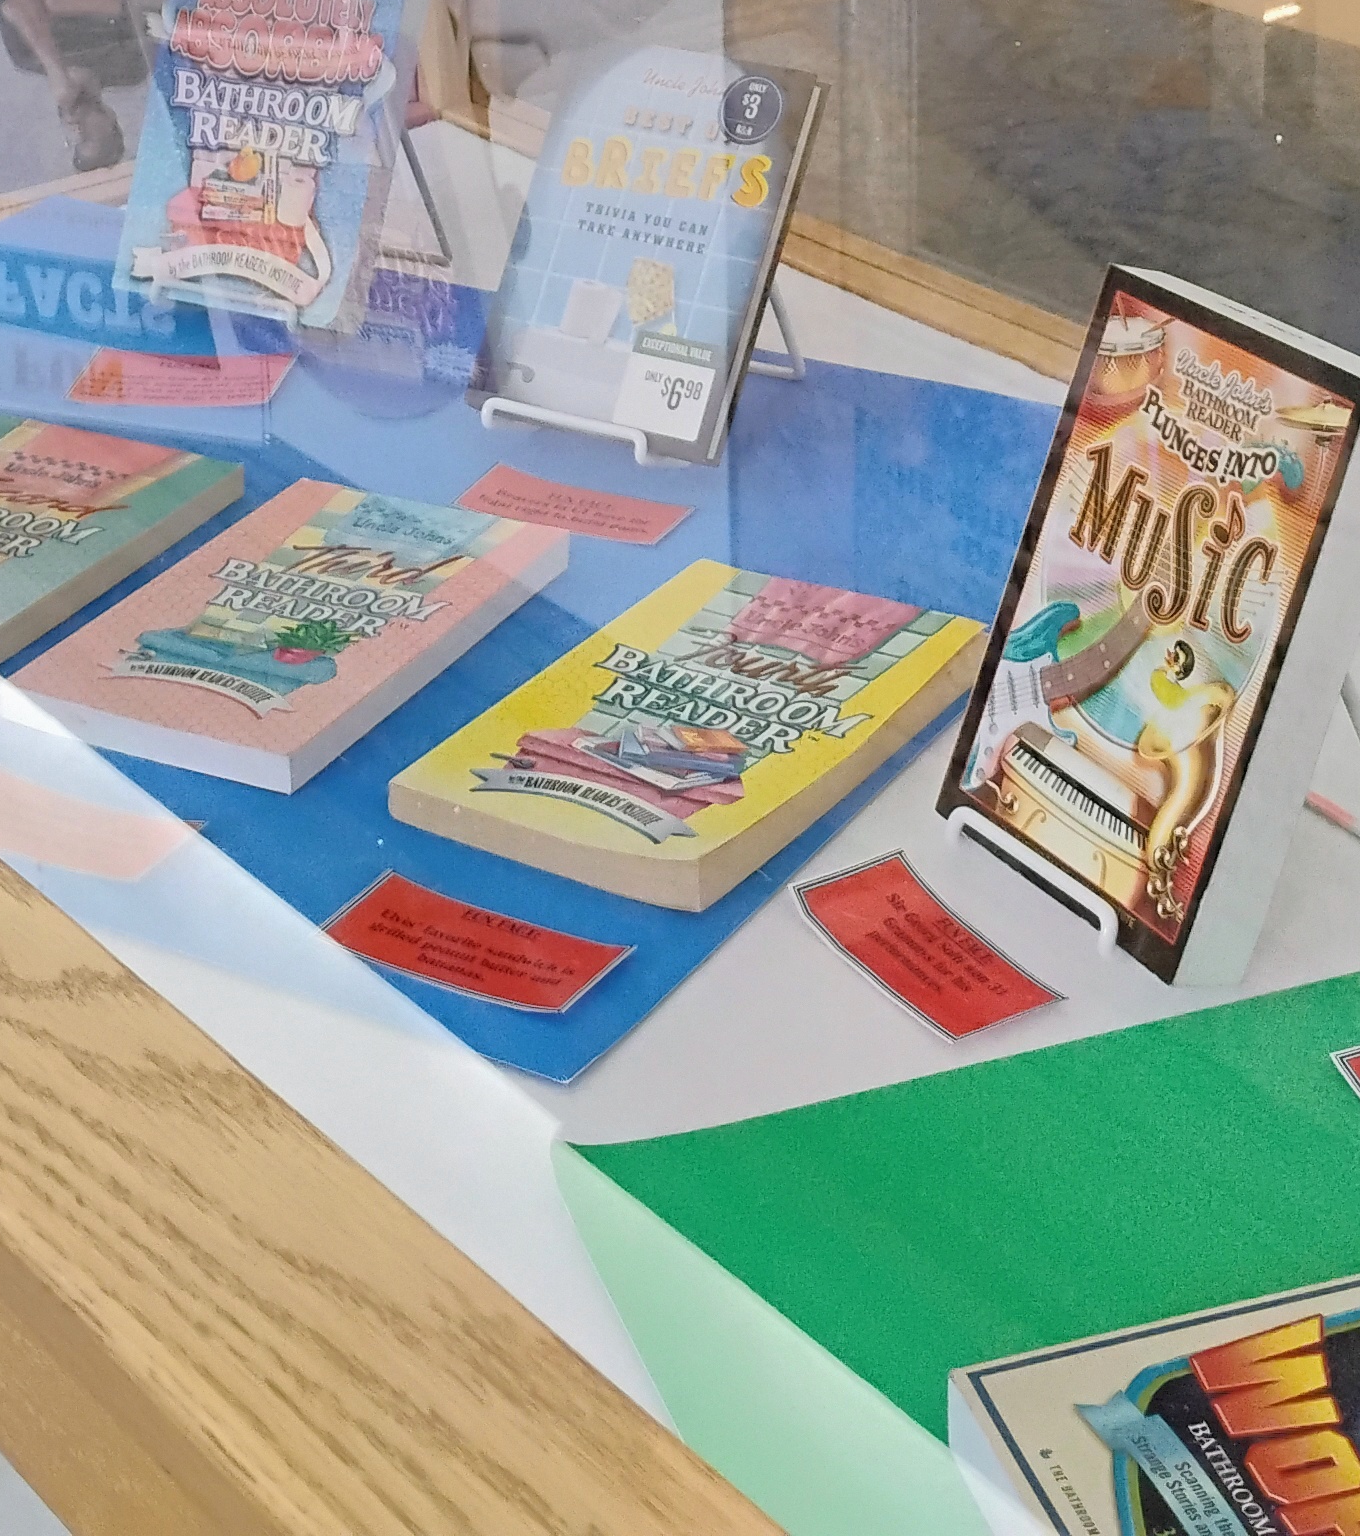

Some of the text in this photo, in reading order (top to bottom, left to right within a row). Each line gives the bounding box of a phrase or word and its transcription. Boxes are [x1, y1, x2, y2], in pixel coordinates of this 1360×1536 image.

[170, 6, 386, 85] ABSORBING
[172, 68, 366, 135] BATHROOM
[642, 68, 687, 91] Uncle
[748, 80, 769, 94] ONLY
[623, 104, 693, 136] BEST
[742, 92, 761, 120] $3
[189, 111, 331, 167] READER
[560, 135, 773, 208] BRIEFS
[578, 219, 707, 255] TAKE ANYWHERE
[586, 202, 709, 236] TRIVIA YOU CAN
[192, 251, 234, 269] BATHROOM
[268, 266, 304, 295] INSTITUTE
[641, 336, 714, 362] EXCEPTIONAL VALUE
[644, 369, 663, 383] ONLY
[1174, 348, 1273, 415] Uncle John's
[1182, 379, 1259, 431] BATHROOM
[1186, 402, 1243, 443] READER
[1142, 387, 1223, 474] PLUNGES
[352, 515, 400, 534] Uncle
[286, 543, 466, 585] Third
[205, 583, 389, 637] READER
[207, 556, 453, 622] BATHROOM
[674, 629, 868, 698] Fourth
[592, 643, 875, 738] BATHROOM
[592, 676, 805, 754] READER
[523, 776, 583, 796] BATHROOM
[885, 892, 907, 912] Sir
[368, 921, 563, 986] grilled peanut butter and
[423, 925, 482, 950] favorite
[486, 945, 558, 972] sandwich
[1049, 1464, 1068, 1487] THE
[1130, 1434, 1170, 1481] Strange
[1165, 1479, 1201, 1526] Stories
[1174, 1460, 1237, 1536] Scanning the
[1187, 1420, 1279, 1536] BATHROOM
